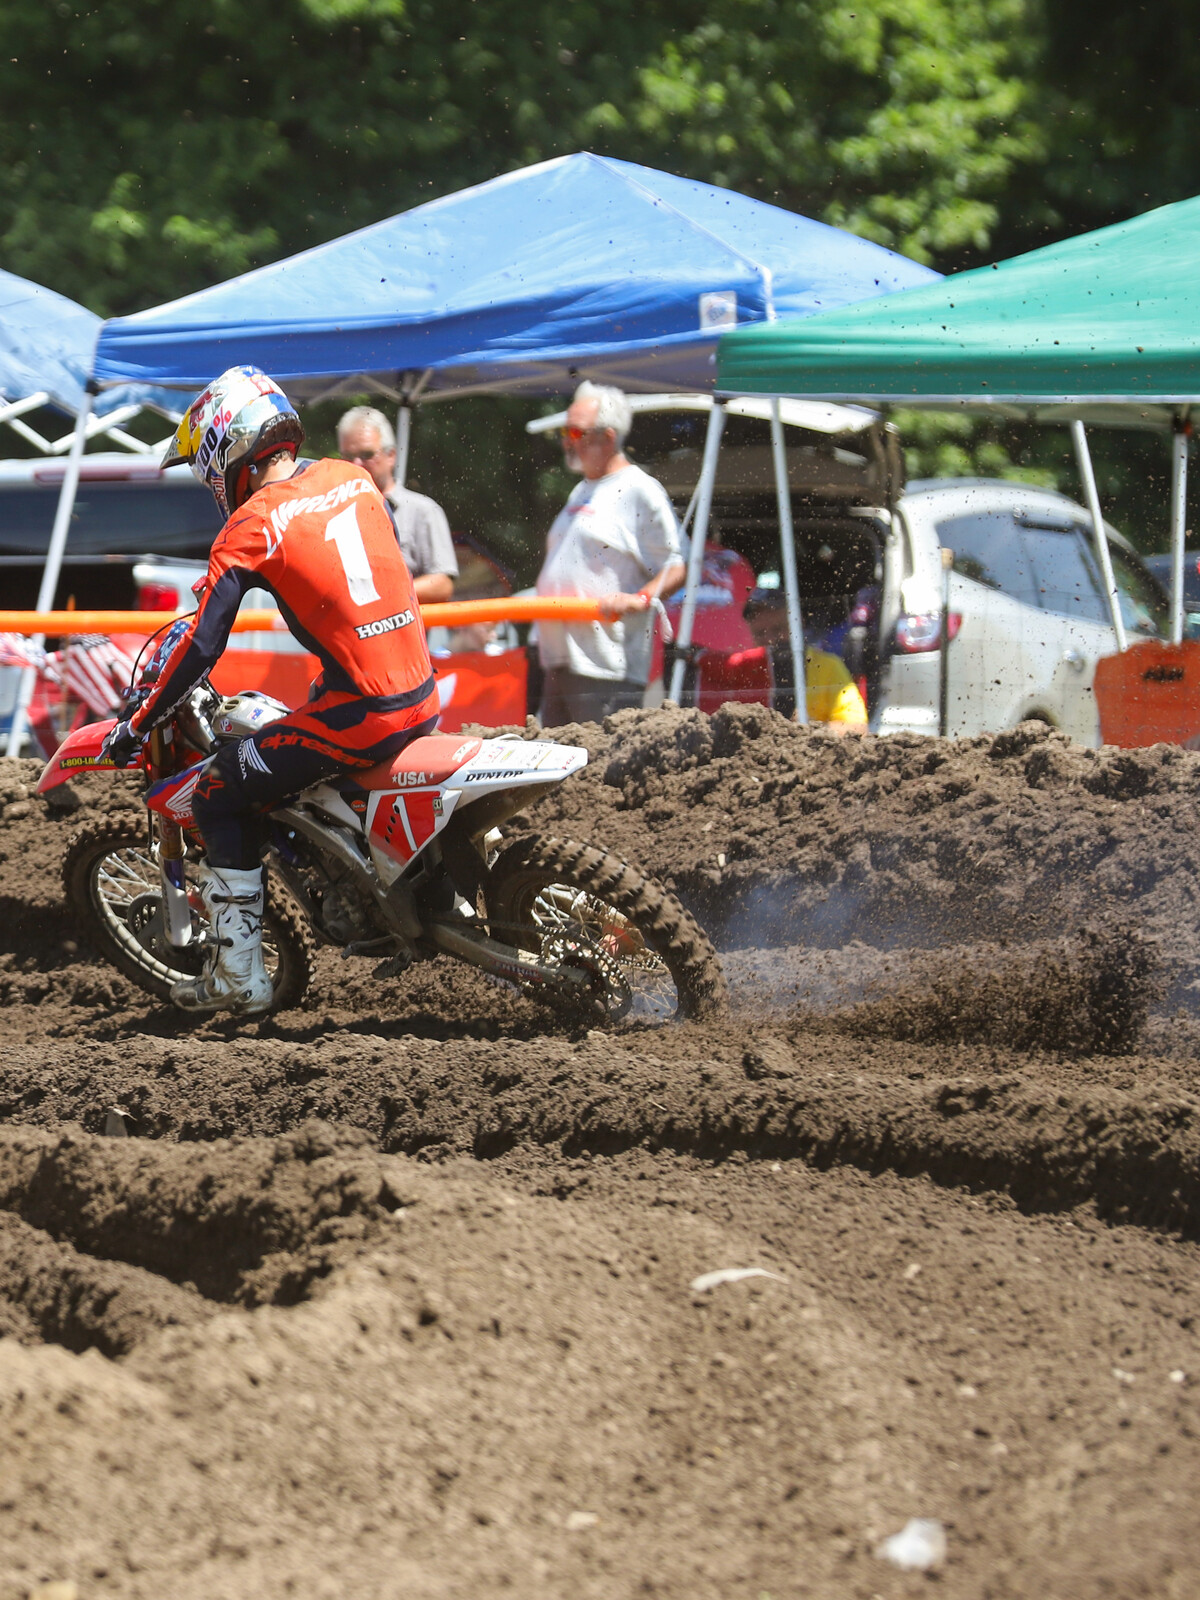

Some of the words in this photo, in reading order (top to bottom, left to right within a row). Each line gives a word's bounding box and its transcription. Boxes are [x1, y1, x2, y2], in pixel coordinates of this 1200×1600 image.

[324, 501, 381, 607] 1
[354, 609, 416, 640] HONDA
[260, 732, 375, 768] alpinestars
[397, 771, 427, 787] USA
[464, 770, 524, 783] DUNLOP
[172, 810, 193, 820] HON
